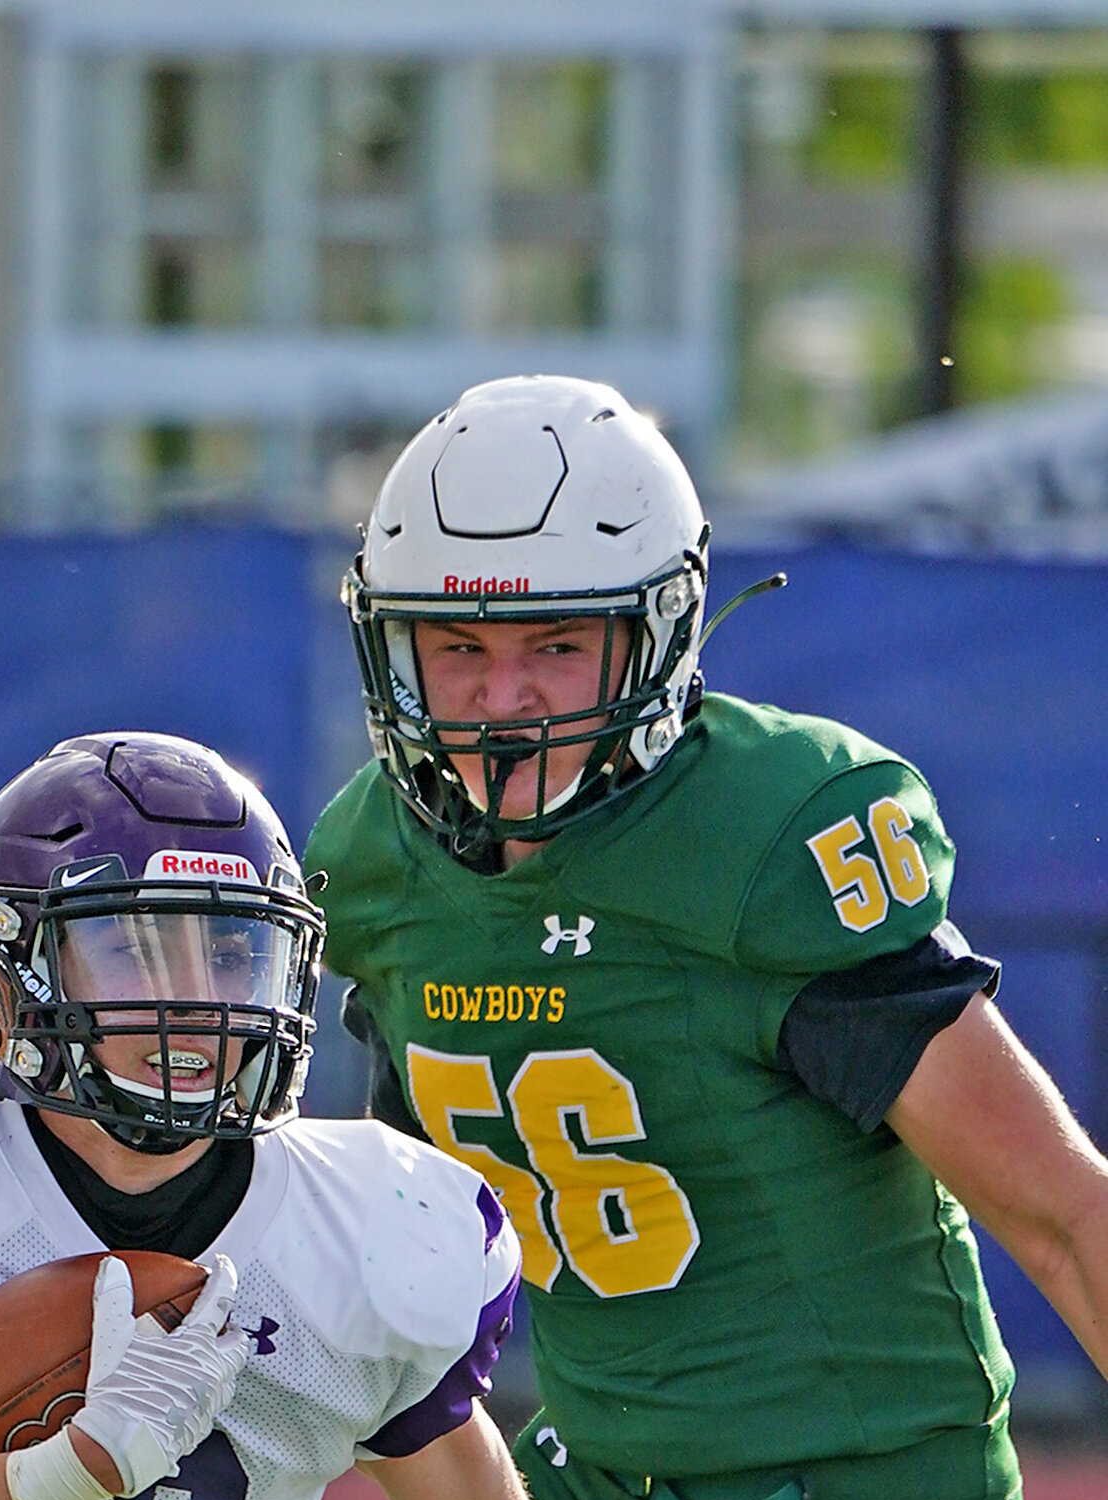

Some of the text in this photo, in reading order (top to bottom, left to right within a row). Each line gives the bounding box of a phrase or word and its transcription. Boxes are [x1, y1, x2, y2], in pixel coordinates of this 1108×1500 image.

[443, 574, 529, 594] Riddell
[162, 855, 248, 879] Riddell
[805, 796, 931, 934] 56
[423, 981, 567, 1023] COWBOYS
[407, 1042, 701, 1298] 56
